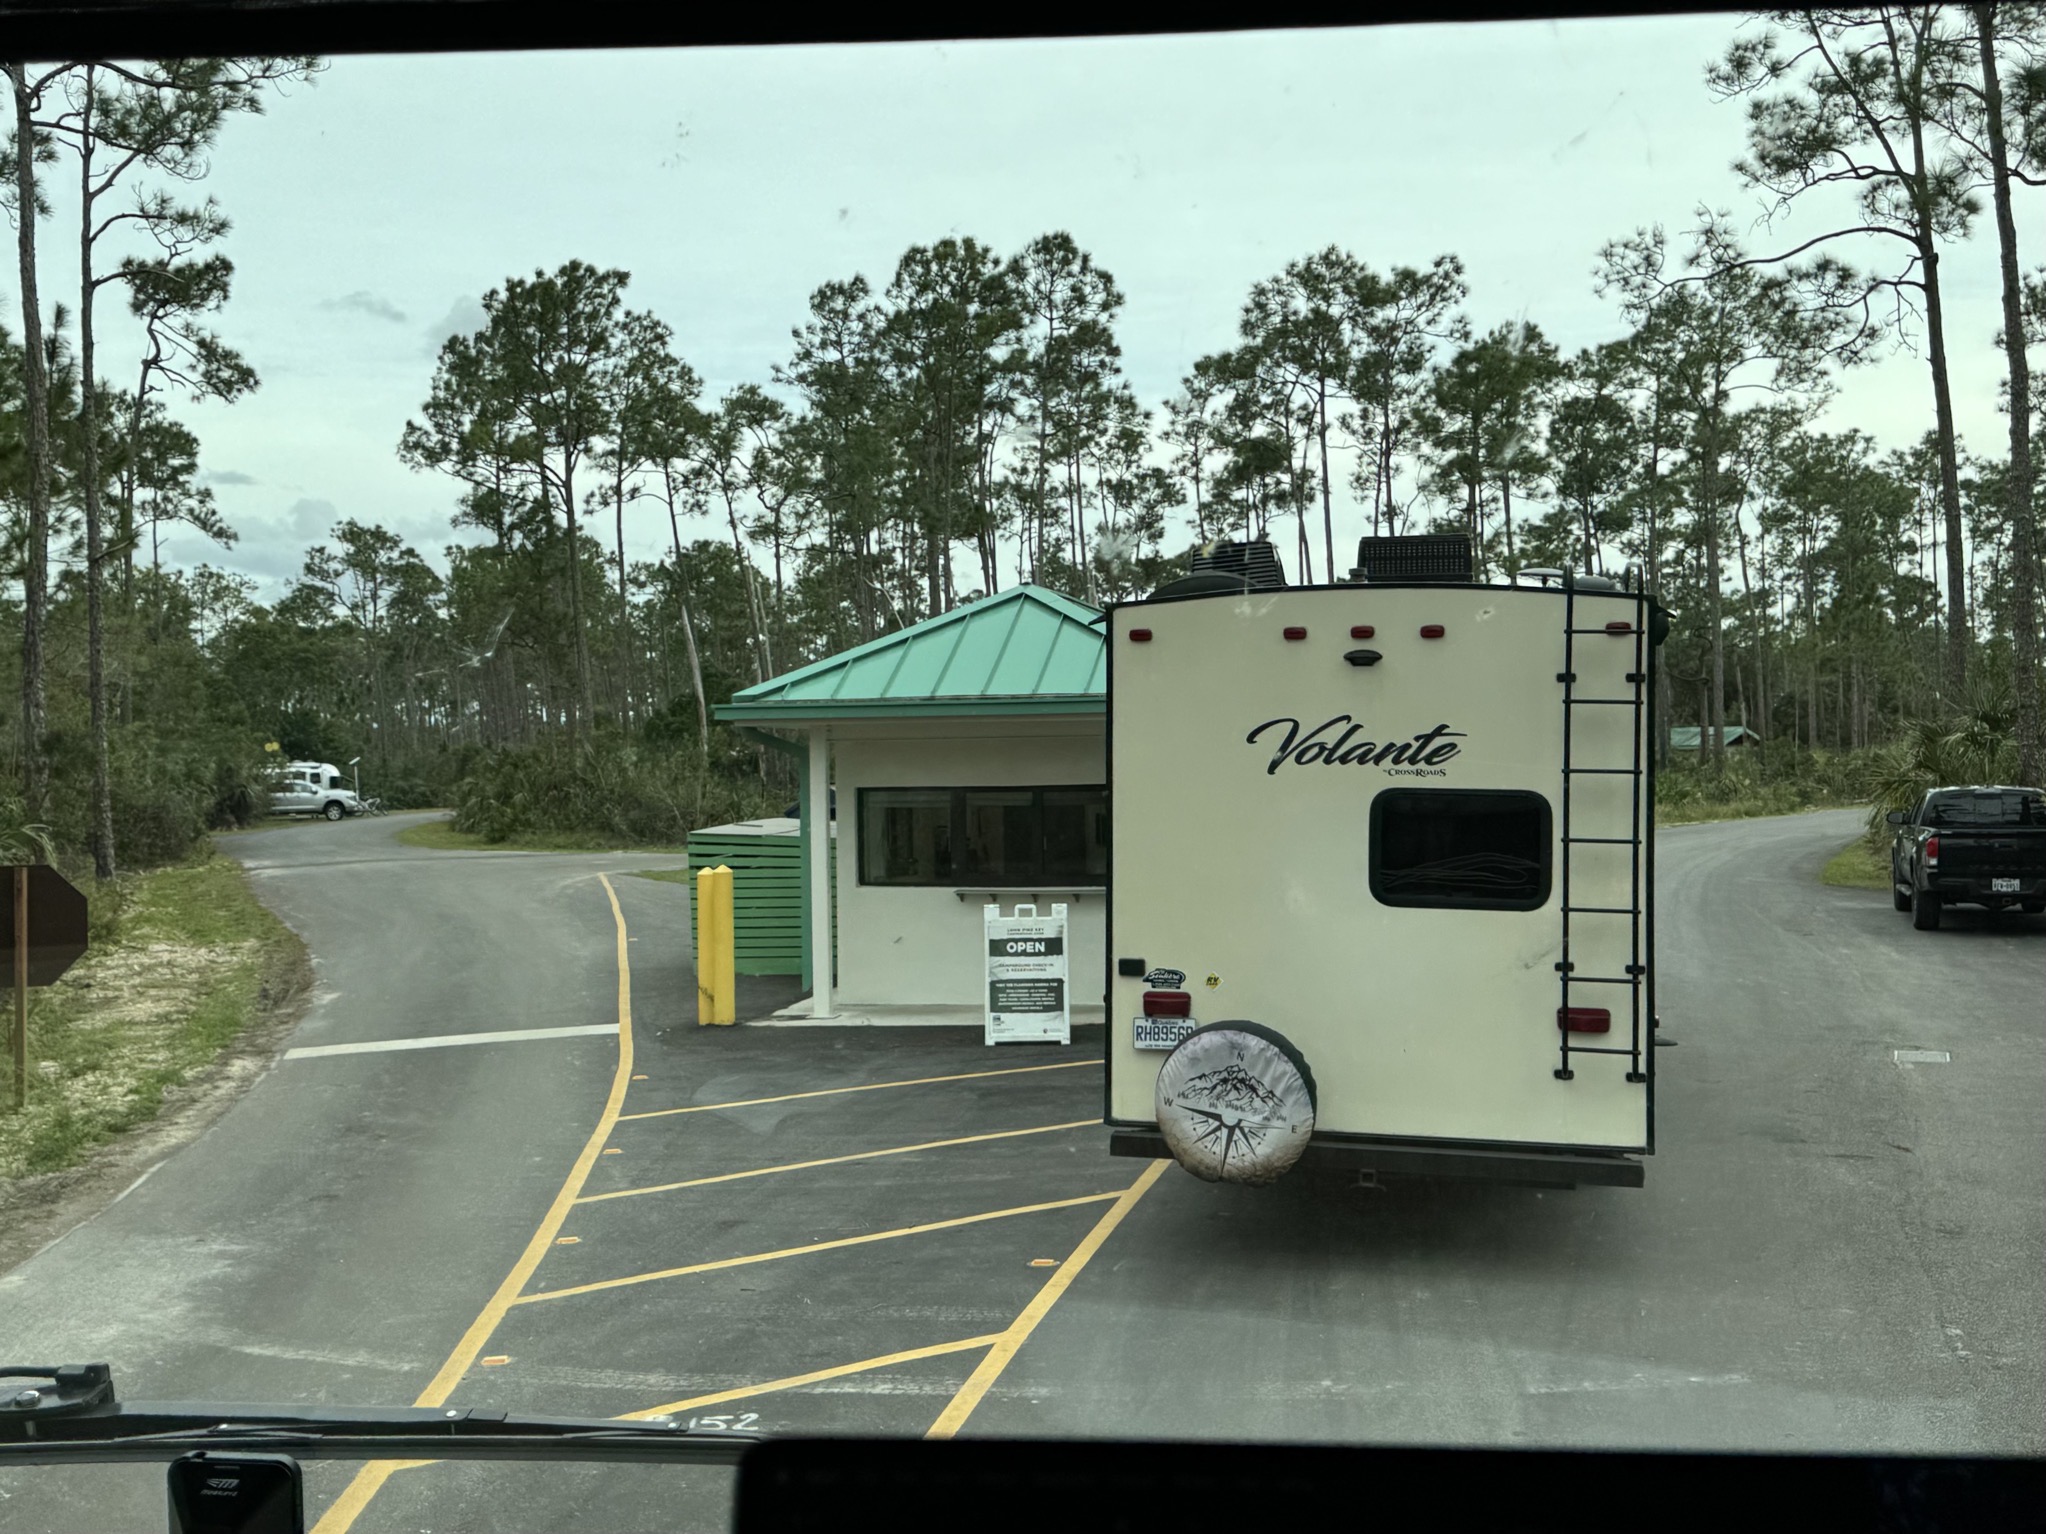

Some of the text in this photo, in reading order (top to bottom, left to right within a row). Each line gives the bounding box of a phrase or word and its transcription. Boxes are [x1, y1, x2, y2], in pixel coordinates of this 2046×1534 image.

[1245, 714, 1468, 776] Volante
[1006, 941, 1045, 953] OPEN
[1236, 1052, 1245, 1062] N
[1163, 1098, 1174, 1107] W
[1291, 1125, 1298, 1133] E
